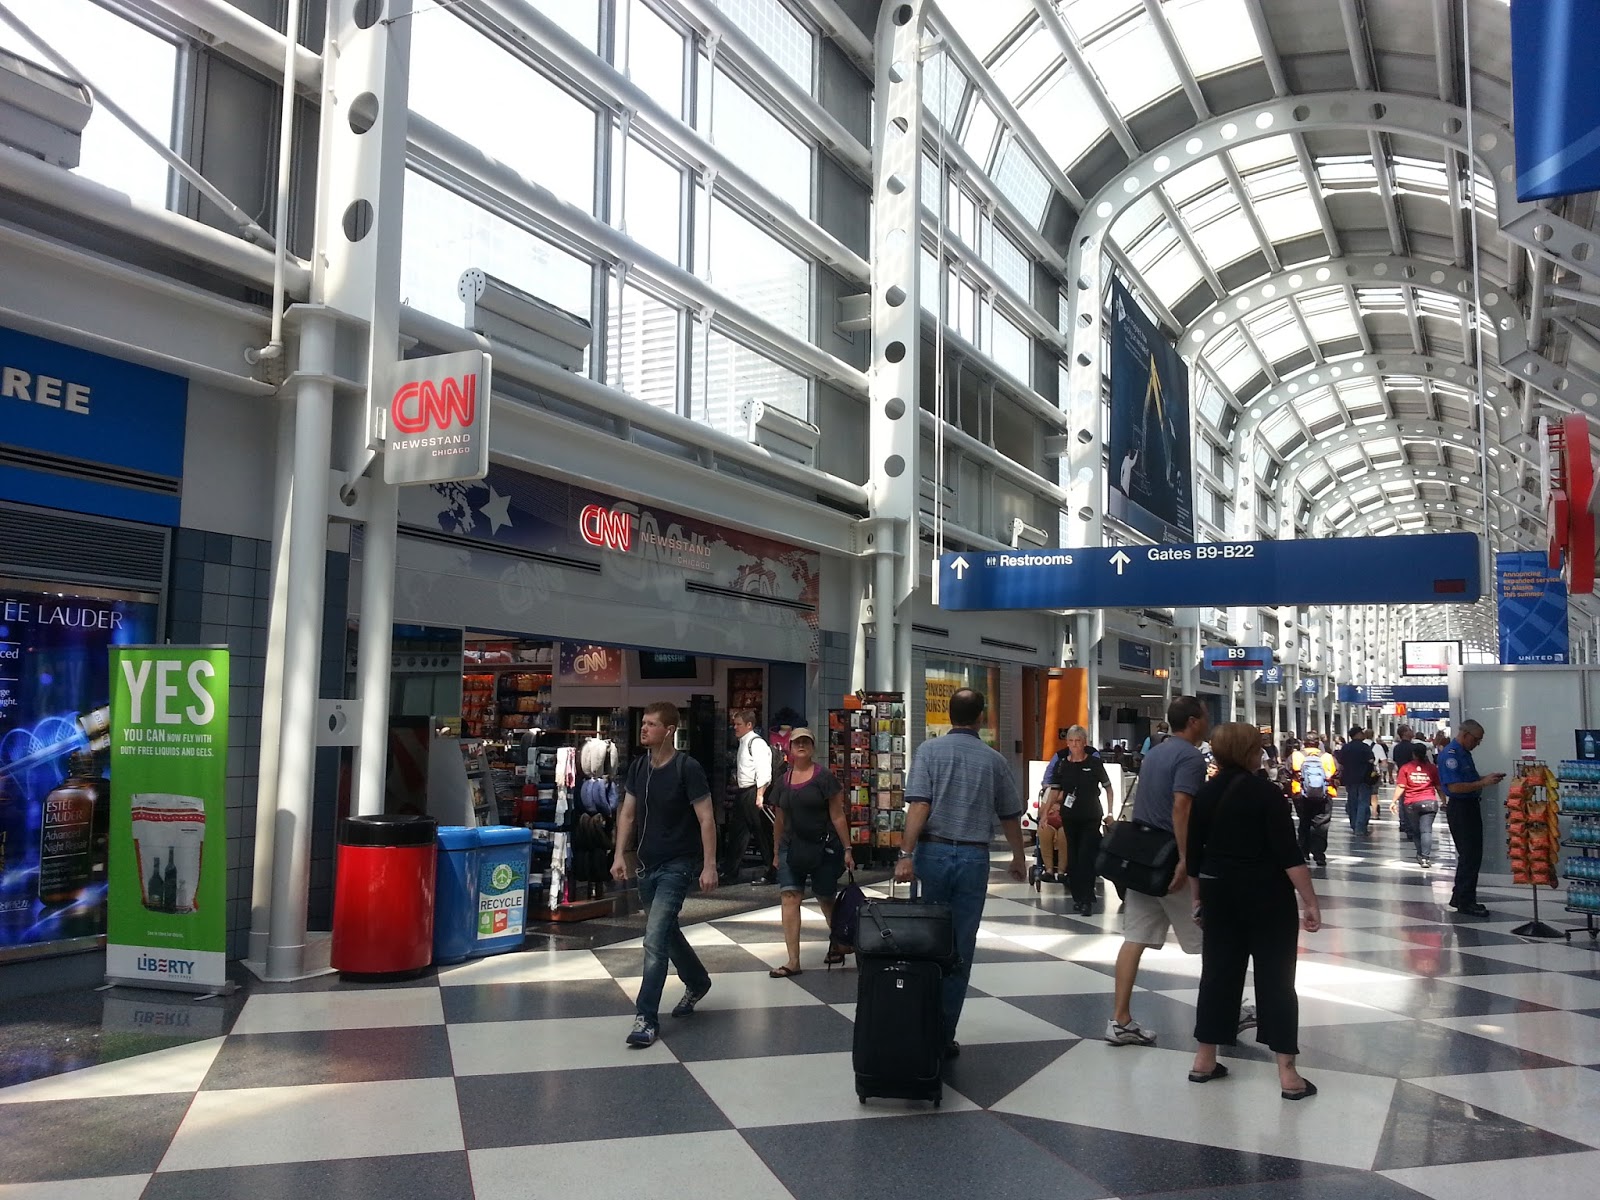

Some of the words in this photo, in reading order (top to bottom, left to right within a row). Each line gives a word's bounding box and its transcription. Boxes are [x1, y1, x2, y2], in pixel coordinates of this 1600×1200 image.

[391, 374, 477, 434] CNN
[392, 434, 471, 451] NEWSSTAND
[432, 447, 470, 457] CHICAGO
[579, 504, 632, 552] CNN
[640, 531, 712, 557] NEWSSTAND
[1000, 554, 1074, 567] Restrooms
[1147, 547, 1192, 561] Gates
[1196, 545, 1255, 559] B9-B22
[677, 556, 711, 570] CHICAGO
[38, 604, 123, 630] LAUDER
[1228, 648, 1246, 659] B9
[573, 649, 608, 675] CNN
[121, 659, 215, 726] YES
[123, 728, 143, 742] YOU
[146, 728, 165, 742] CAN
[183, 733, 196, 743] FLY
[196, 734, 212, 743] WITH
[120, 745, 136, 755] DUTY
[138, 746, 153, 756] FREE
[155, 746, 180, 757] LIQUIDS
[182, 747, 195, 757] AND
[480, 896, 522, 911] RECYCLE
